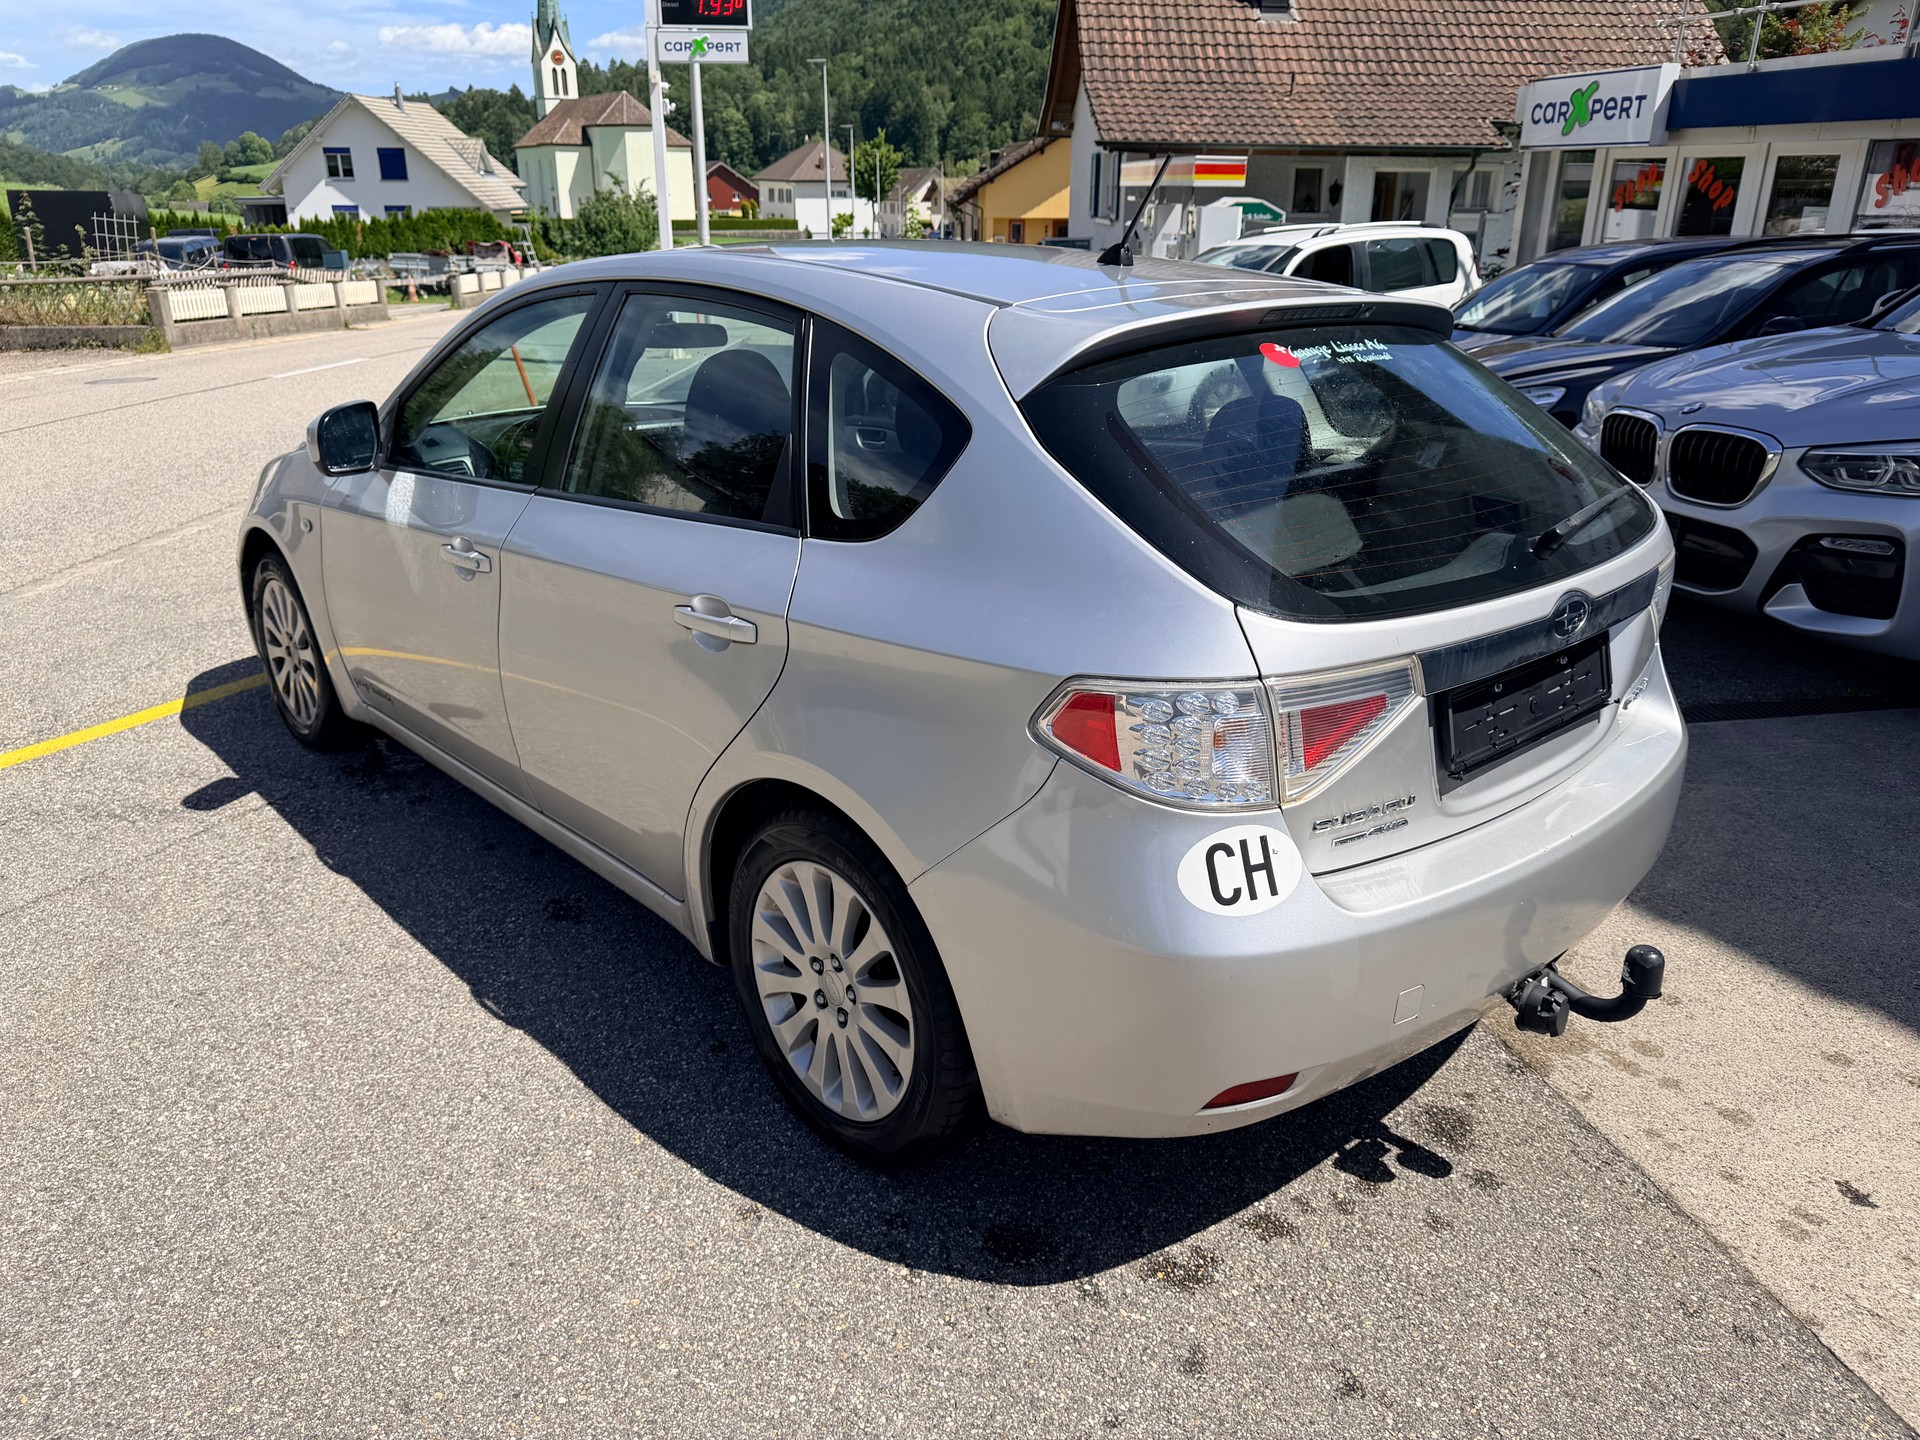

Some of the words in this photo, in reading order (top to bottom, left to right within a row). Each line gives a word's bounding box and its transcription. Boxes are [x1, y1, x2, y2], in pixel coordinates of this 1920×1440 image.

[1614, 162, 1659, 213] Shop
[1687, 159, 1735, 211] Shop
[1312, 794, 1416, 833] SUBARU
[1205, 834, 1279, 907] CH
